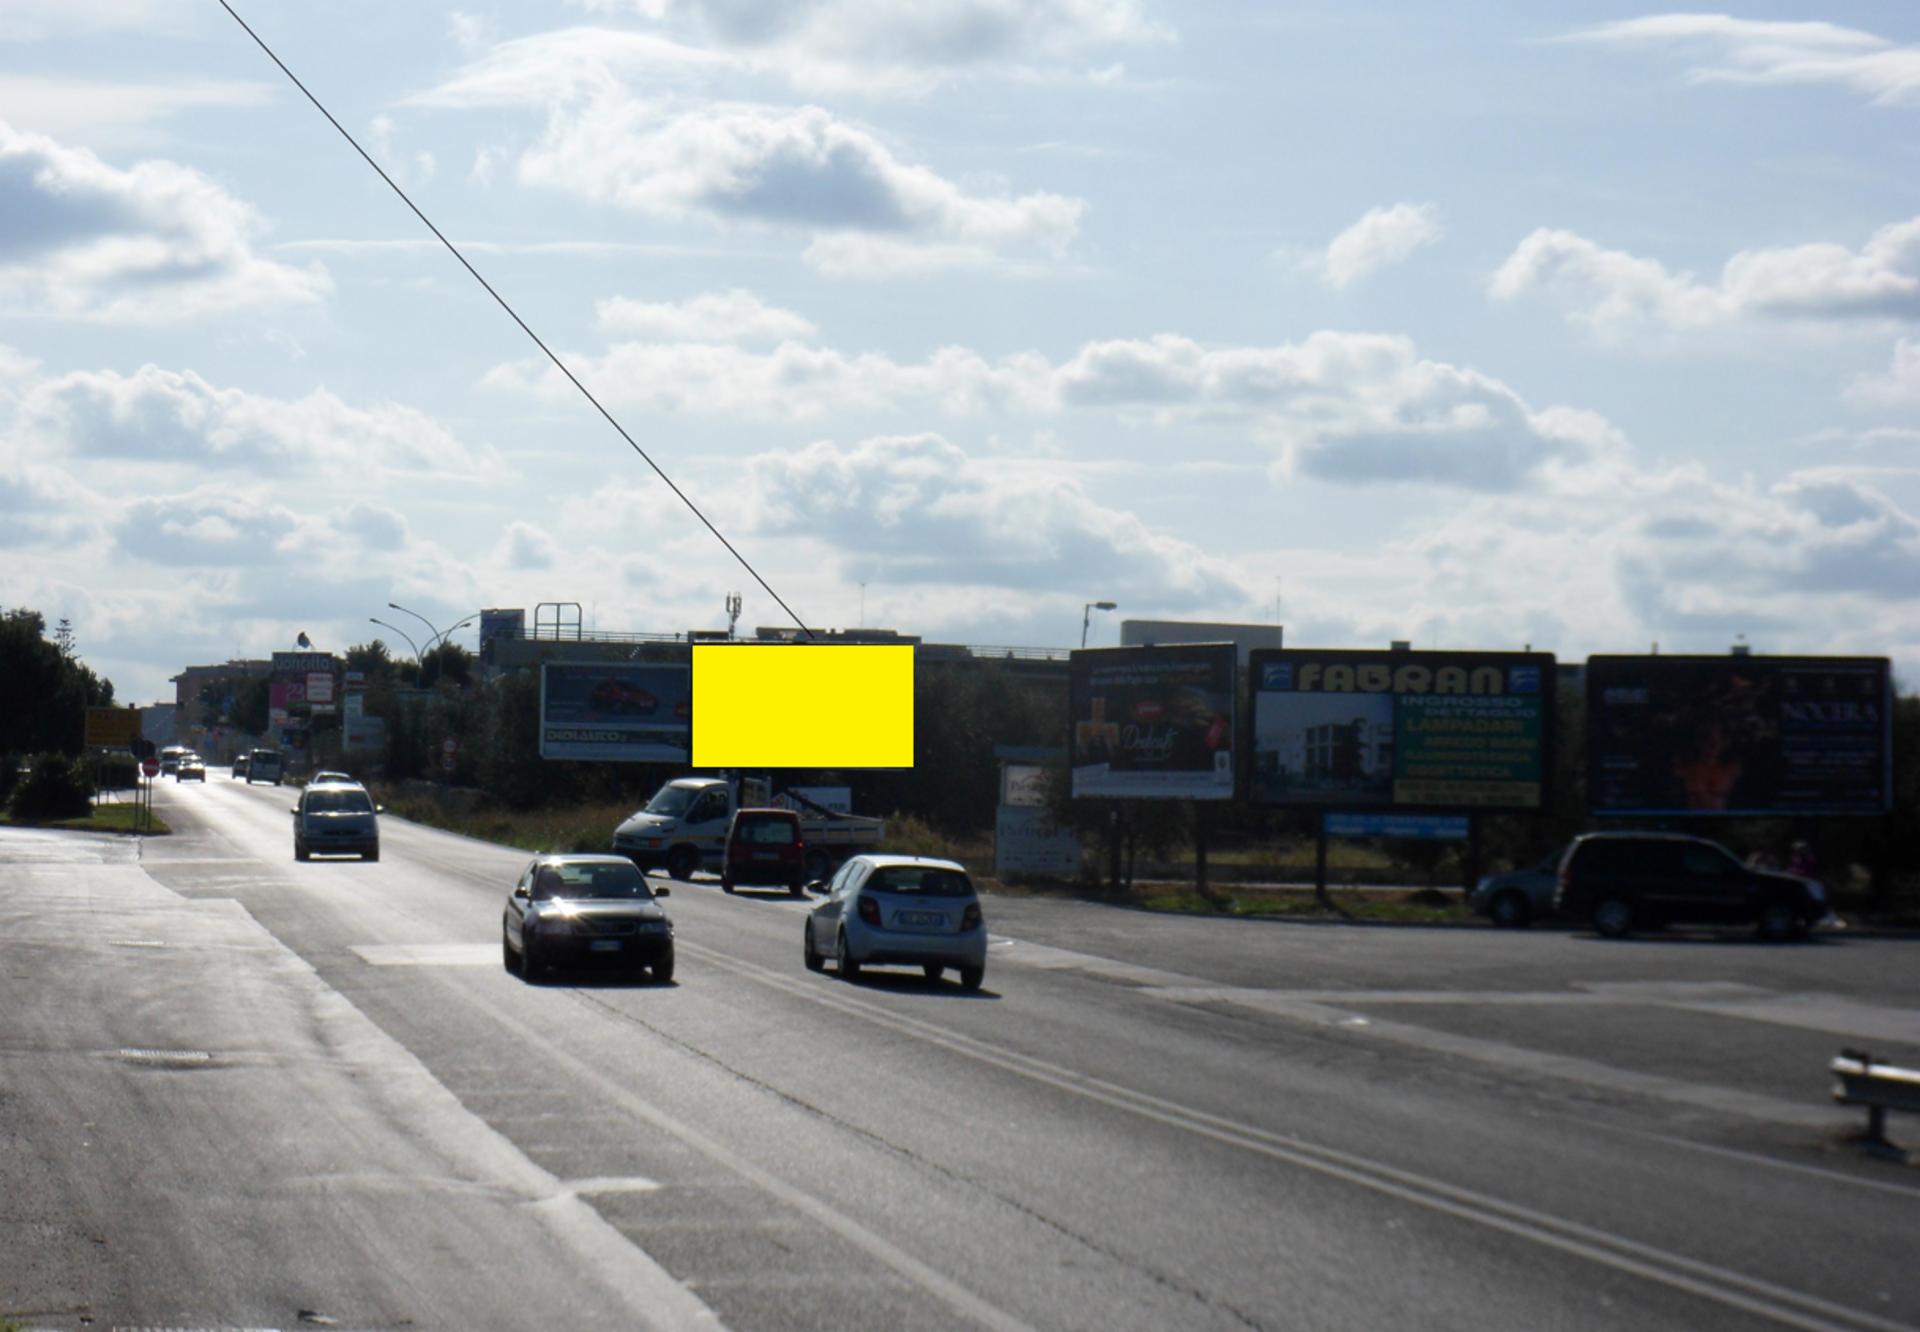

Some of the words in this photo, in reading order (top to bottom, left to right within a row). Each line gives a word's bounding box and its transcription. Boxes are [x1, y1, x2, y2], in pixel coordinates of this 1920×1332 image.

[1297, 663, 1503, 695] FABRAN
[1401, 695, 1523, 707] INGROSSO
[1424, 707, 1537, 718] DETTAGLIO
[1406, 718, 1525, 732] LAMPADARI
